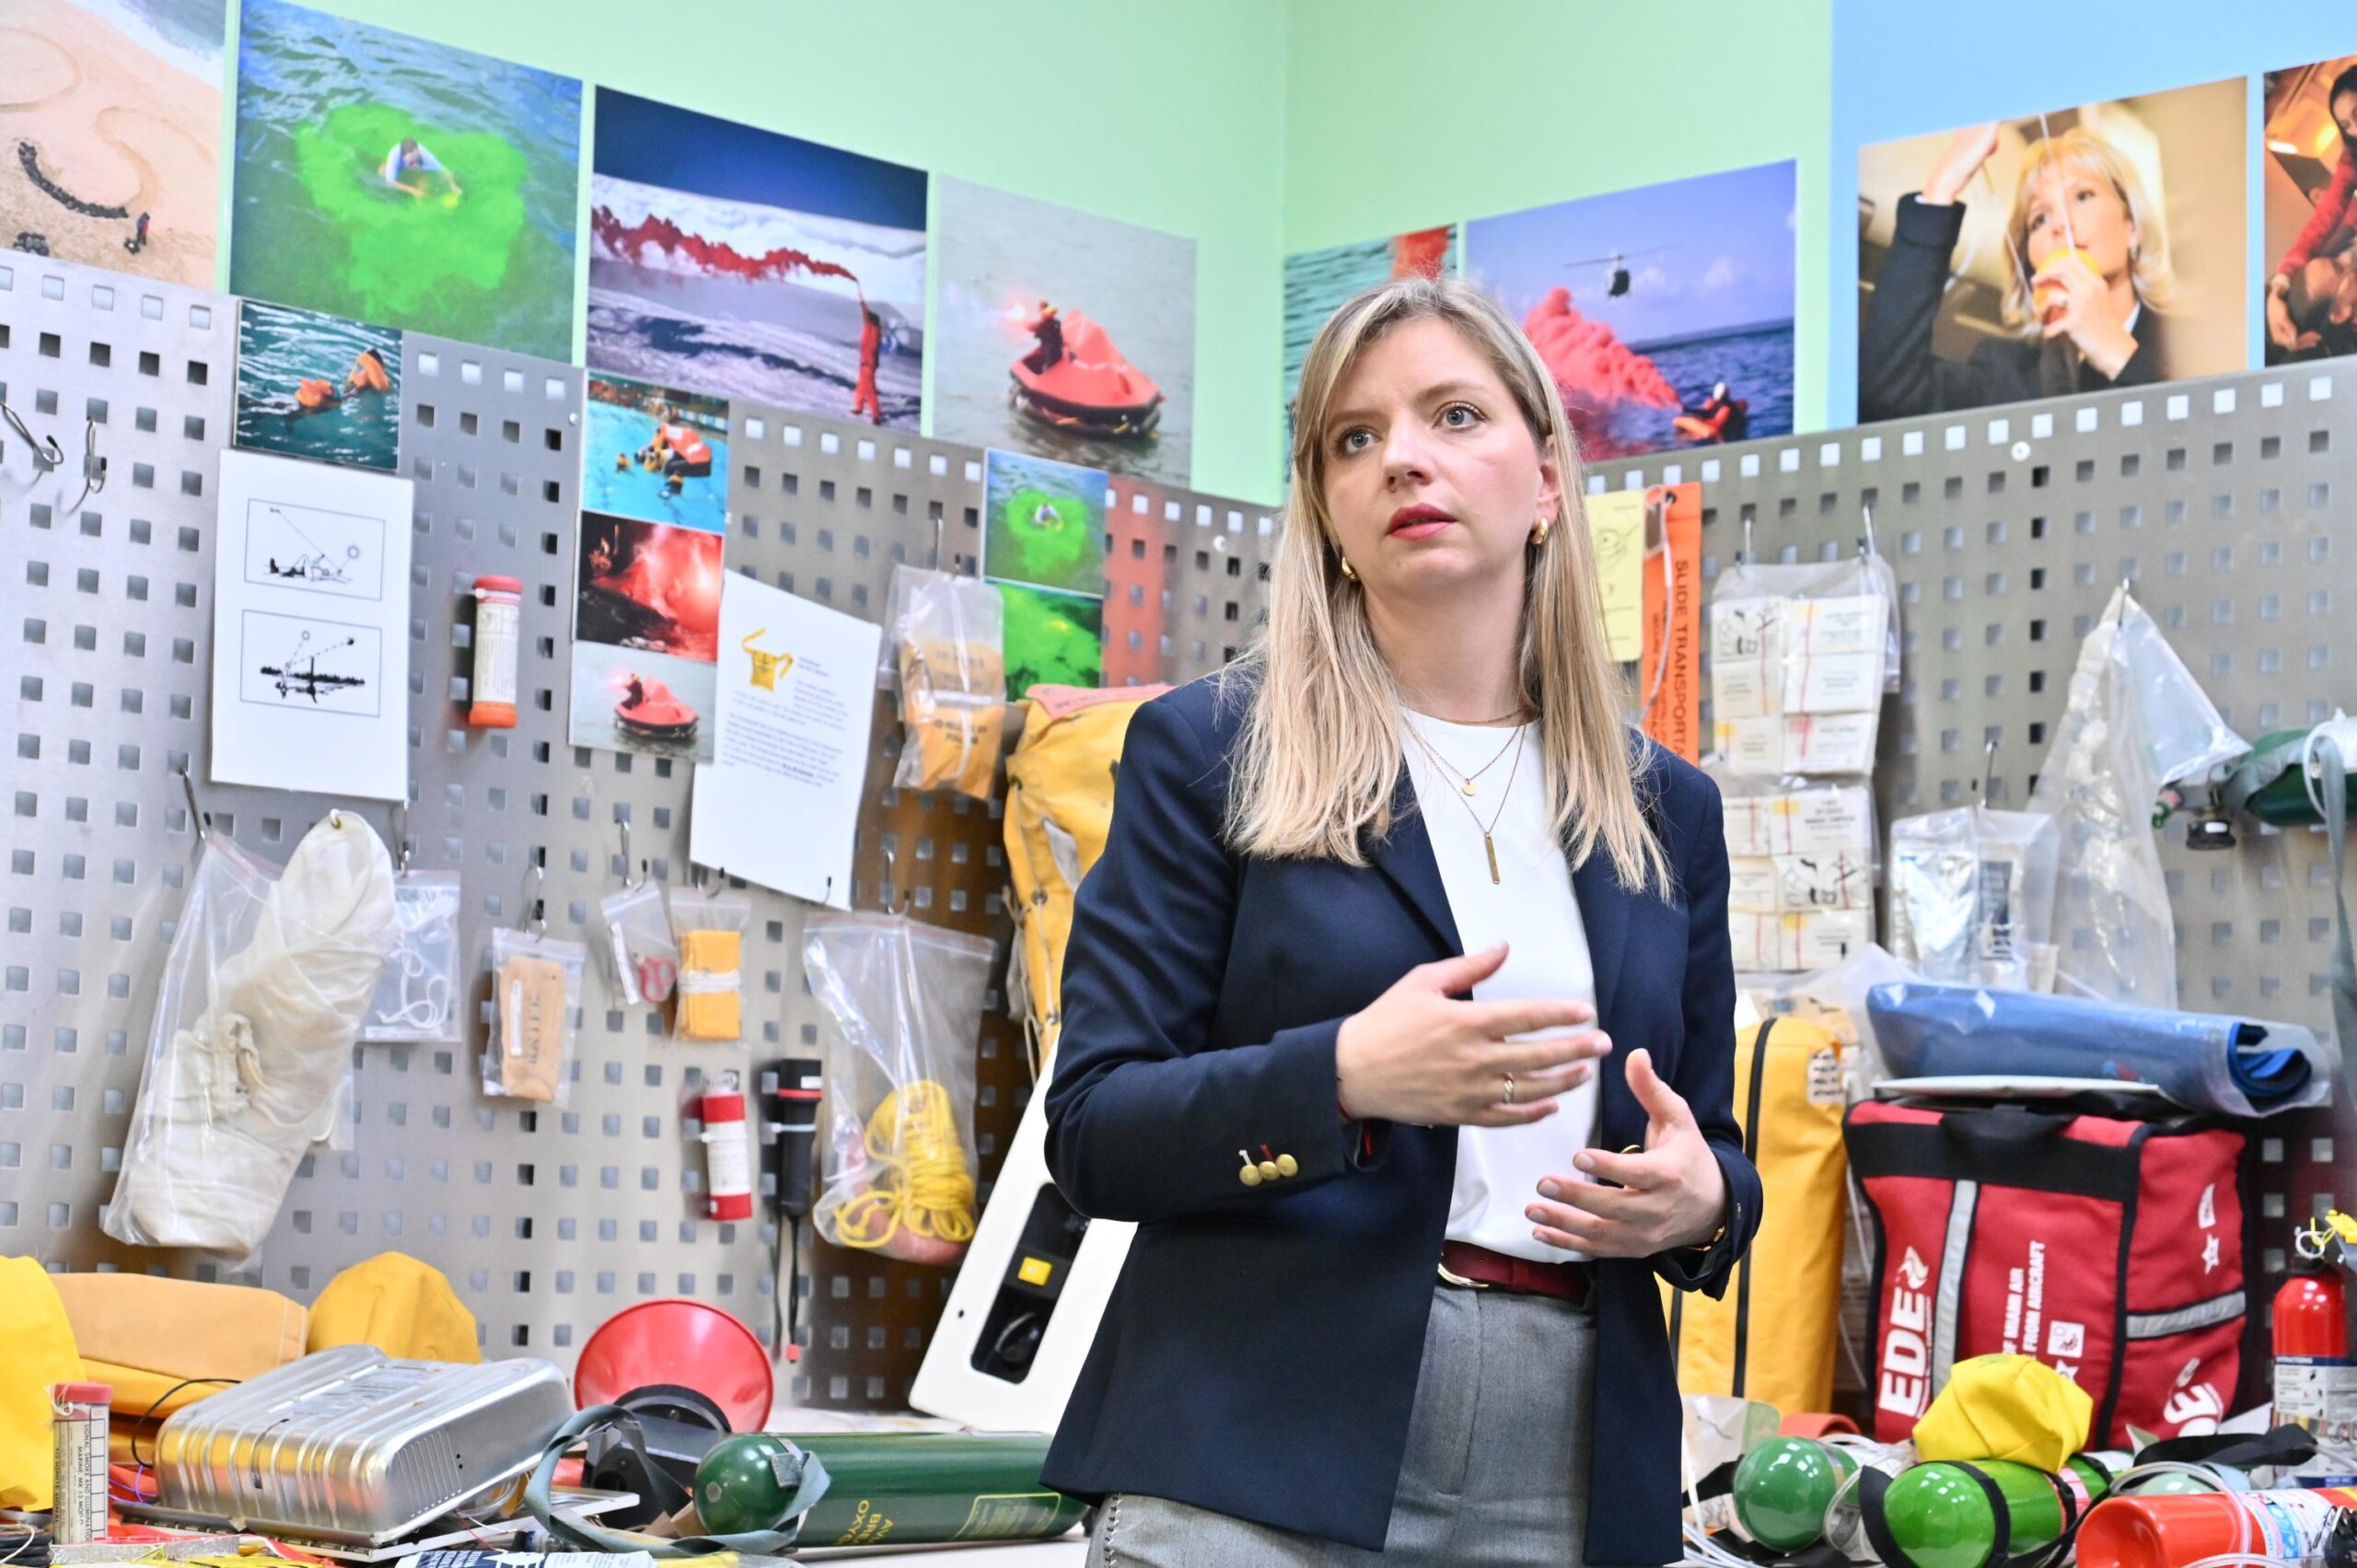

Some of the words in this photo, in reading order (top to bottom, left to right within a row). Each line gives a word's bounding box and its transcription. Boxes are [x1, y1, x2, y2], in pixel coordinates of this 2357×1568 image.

[1675, 560, 1689, 616] SLIDE
[2008, 1268, 2024, 1293] AIR
[2026, 1240, 2046, 1309] AIRCRAFT
[2003, 1294, 2022, 1338] MIAMI
[2025, 1311, 2040, 1352] FROM
